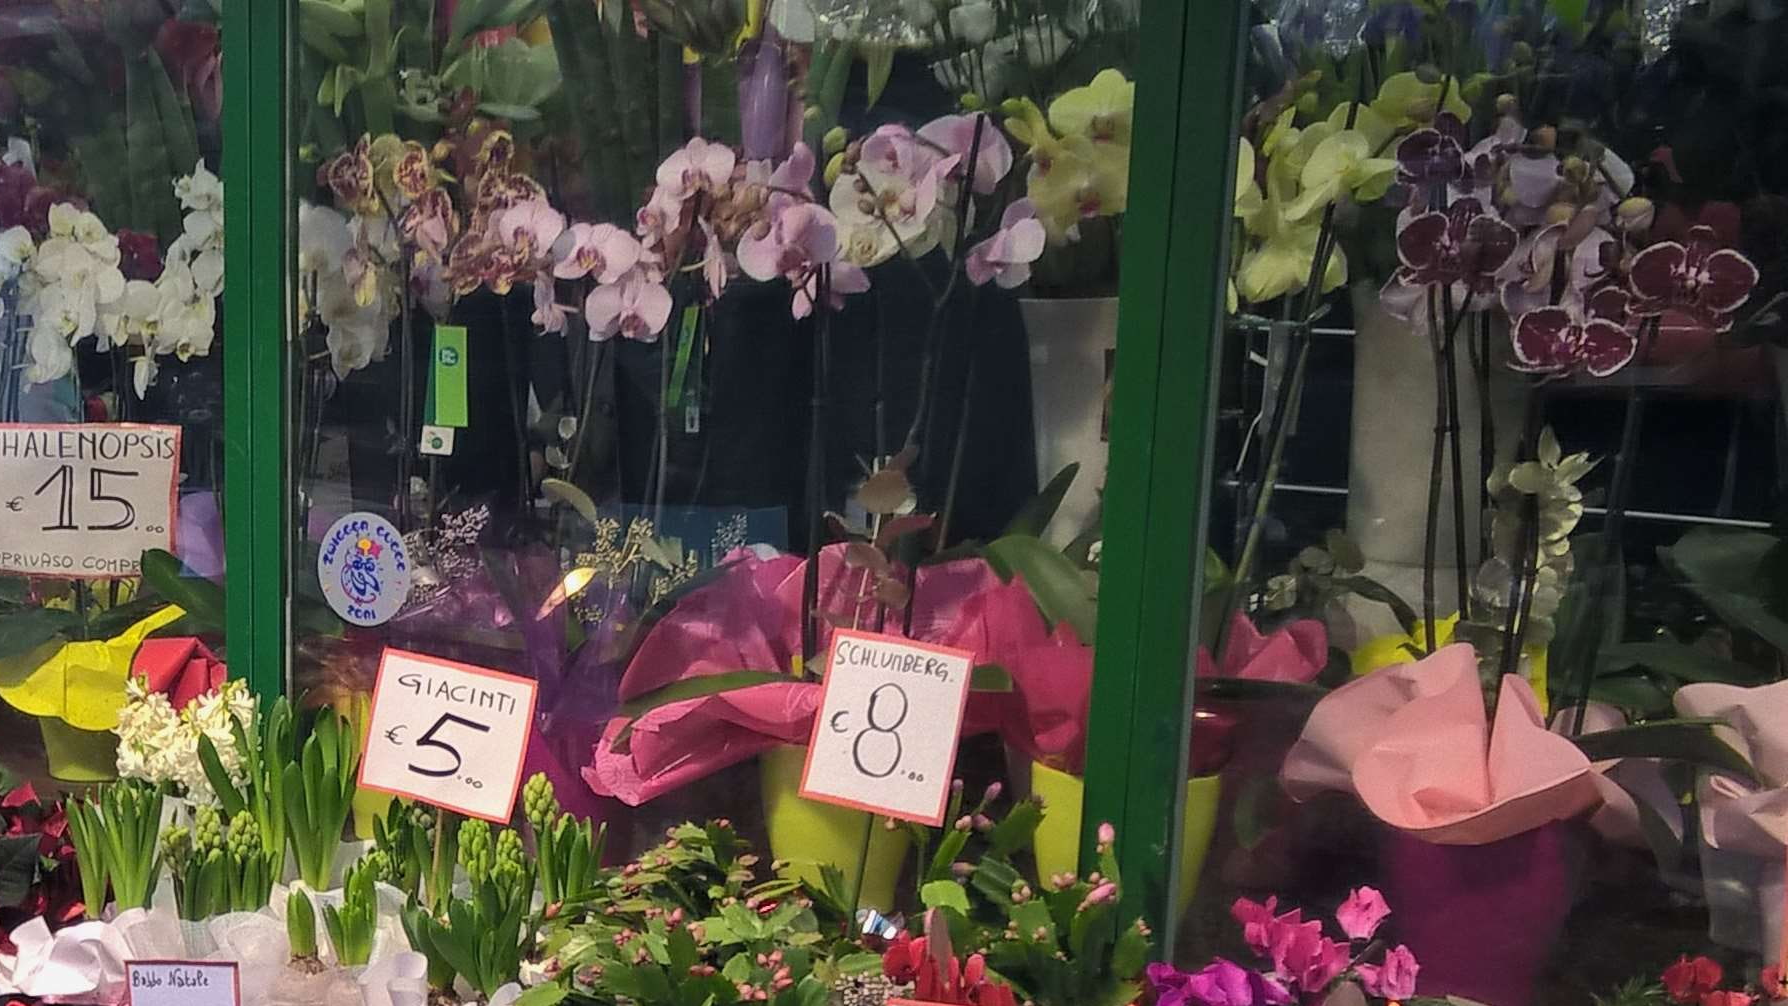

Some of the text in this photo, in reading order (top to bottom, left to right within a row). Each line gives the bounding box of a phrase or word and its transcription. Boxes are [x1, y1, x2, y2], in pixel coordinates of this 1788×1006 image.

[398, 673, 516, 715] GIACINTI
[132, 967, 210, 988] Babbo Natale
